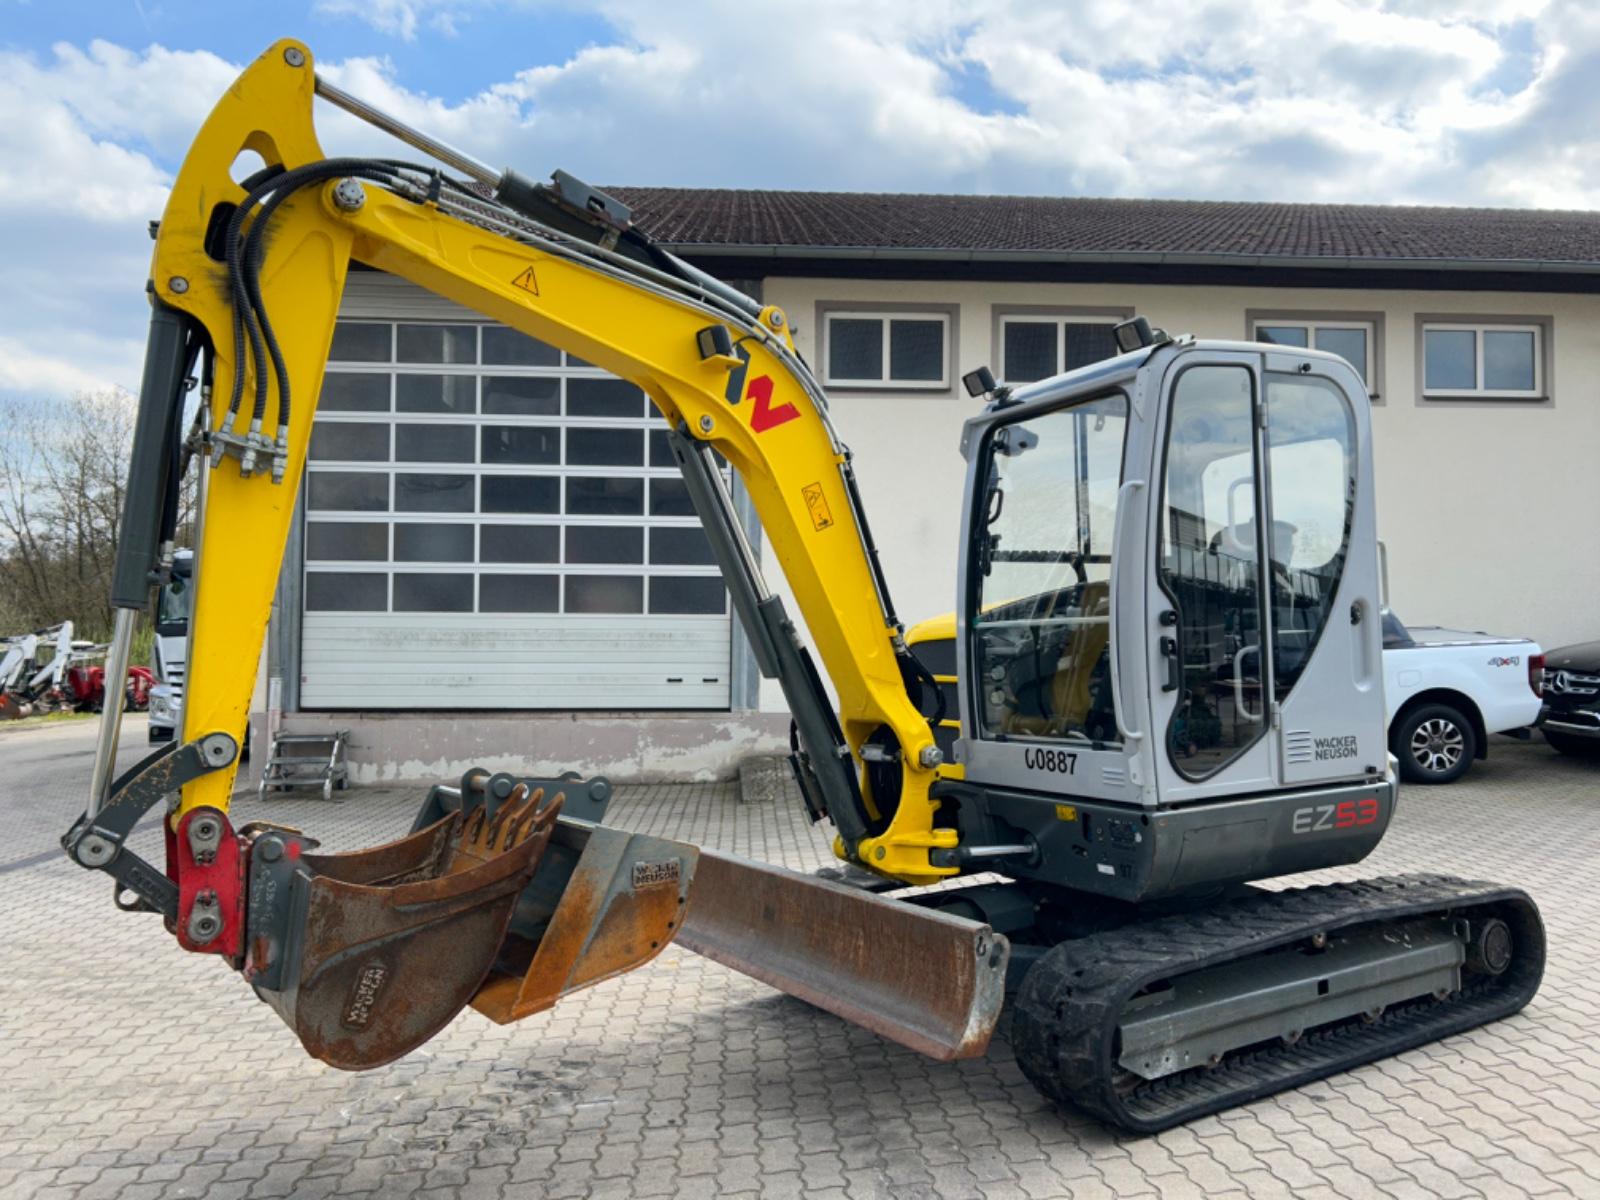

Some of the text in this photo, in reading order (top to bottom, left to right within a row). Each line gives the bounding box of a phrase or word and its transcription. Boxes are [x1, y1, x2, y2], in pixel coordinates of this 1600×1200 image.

[1313, 735, 1357, 749] WACKER
[1314, 747, 1358, 761] NEUSON
[1293, 799, 1377, 834] EZ53
